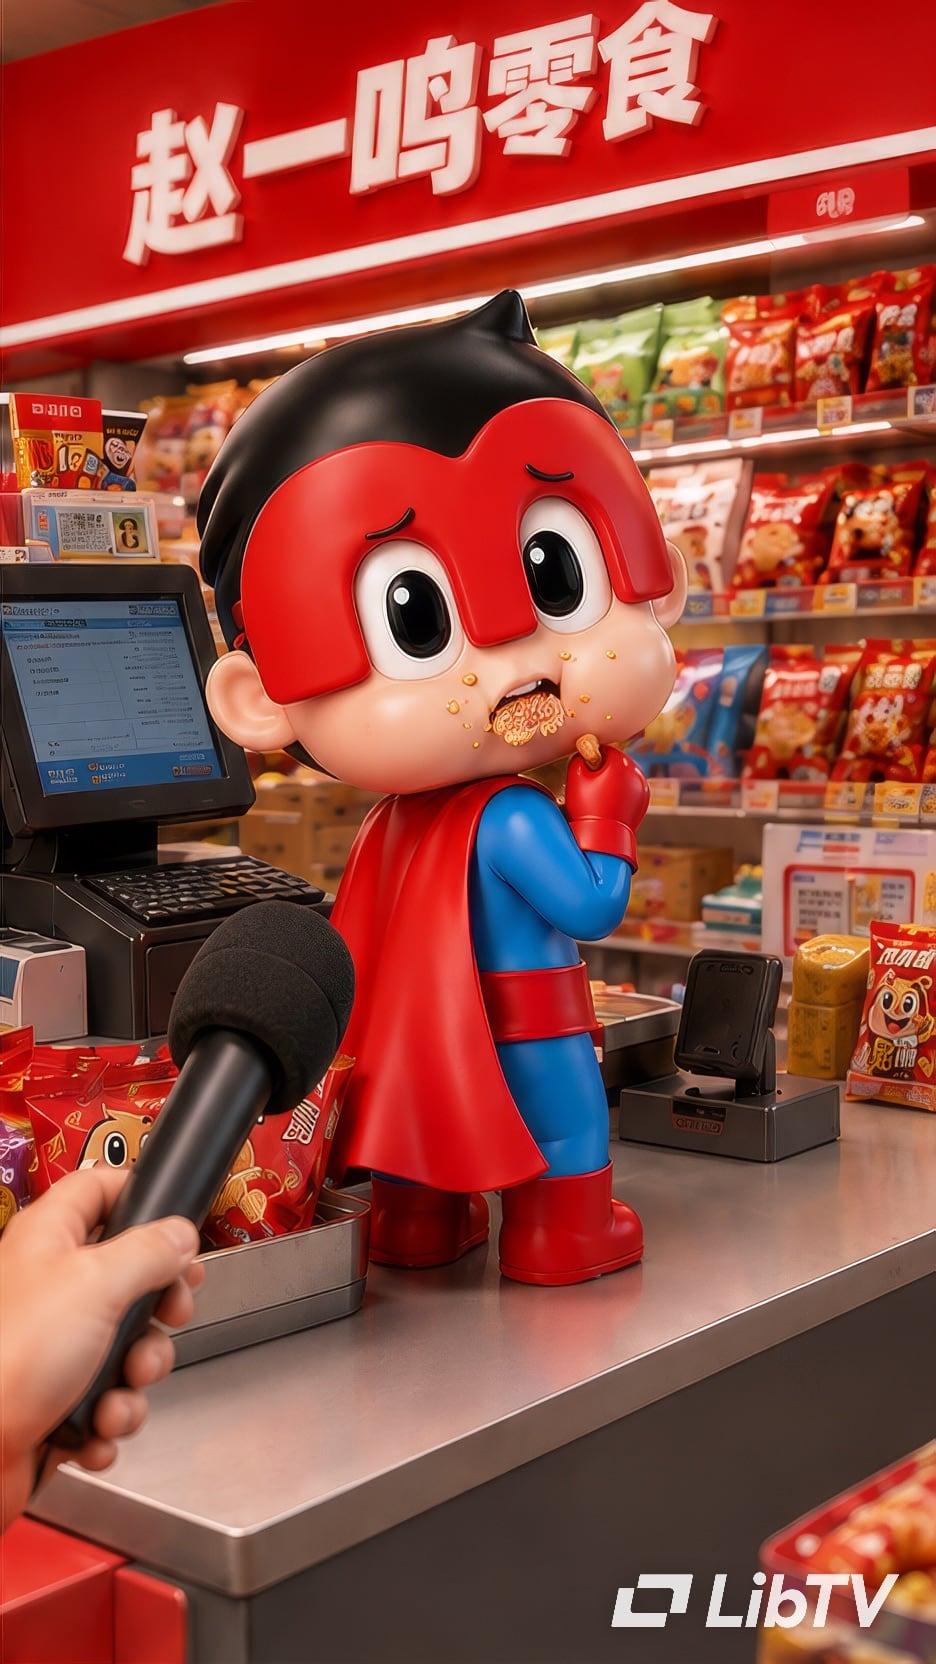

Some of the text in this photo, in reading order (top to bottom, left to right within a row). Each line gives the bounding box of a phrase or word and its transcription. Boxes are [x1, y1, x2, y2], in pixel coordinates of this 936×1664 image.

[122, 0, 717, 267] 赵一鸣零食
